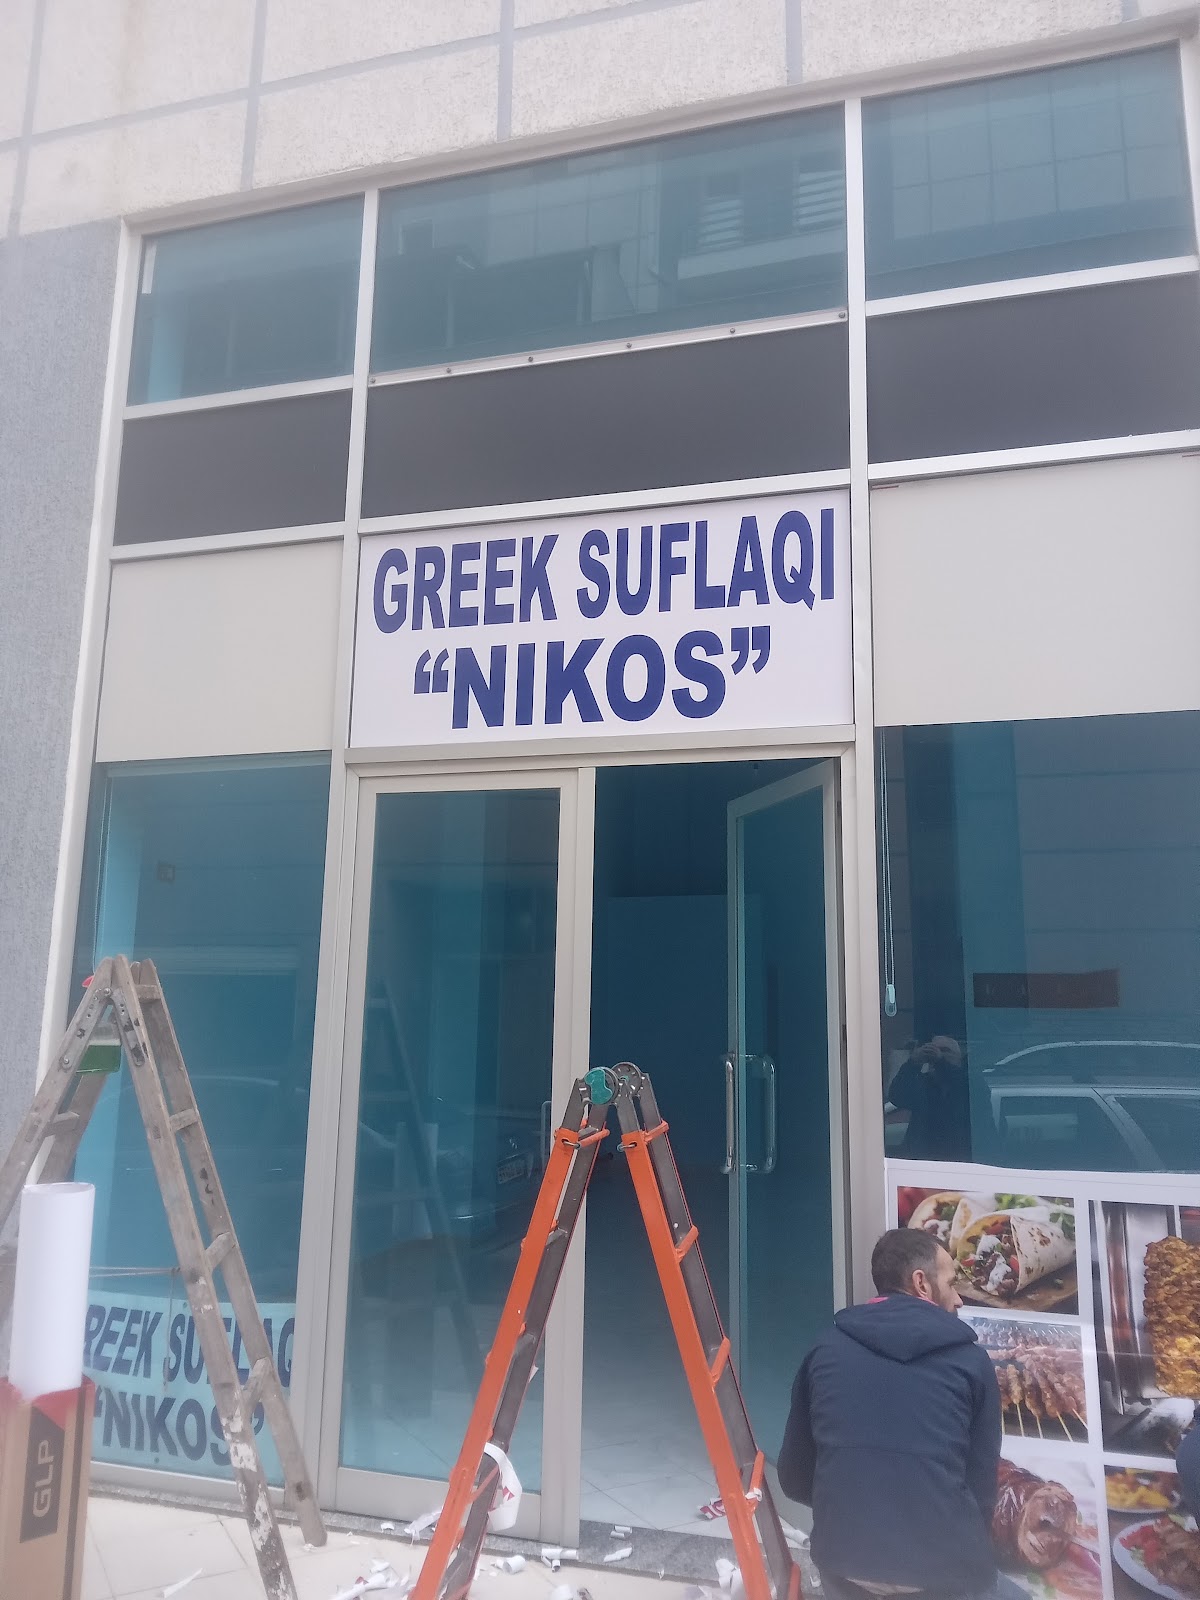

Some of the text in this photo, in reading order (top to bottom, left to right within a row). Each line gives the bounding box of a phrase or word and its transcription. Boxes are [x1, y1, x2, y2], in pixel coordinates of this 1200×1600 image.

[373, 508, 835, 633] GREEK SUFLAQI
[413, 625, 771, 729] “NIKOS”
[83, 1304, 163, 1379] REEK
[32, 1439, 55, 1518] GLP
